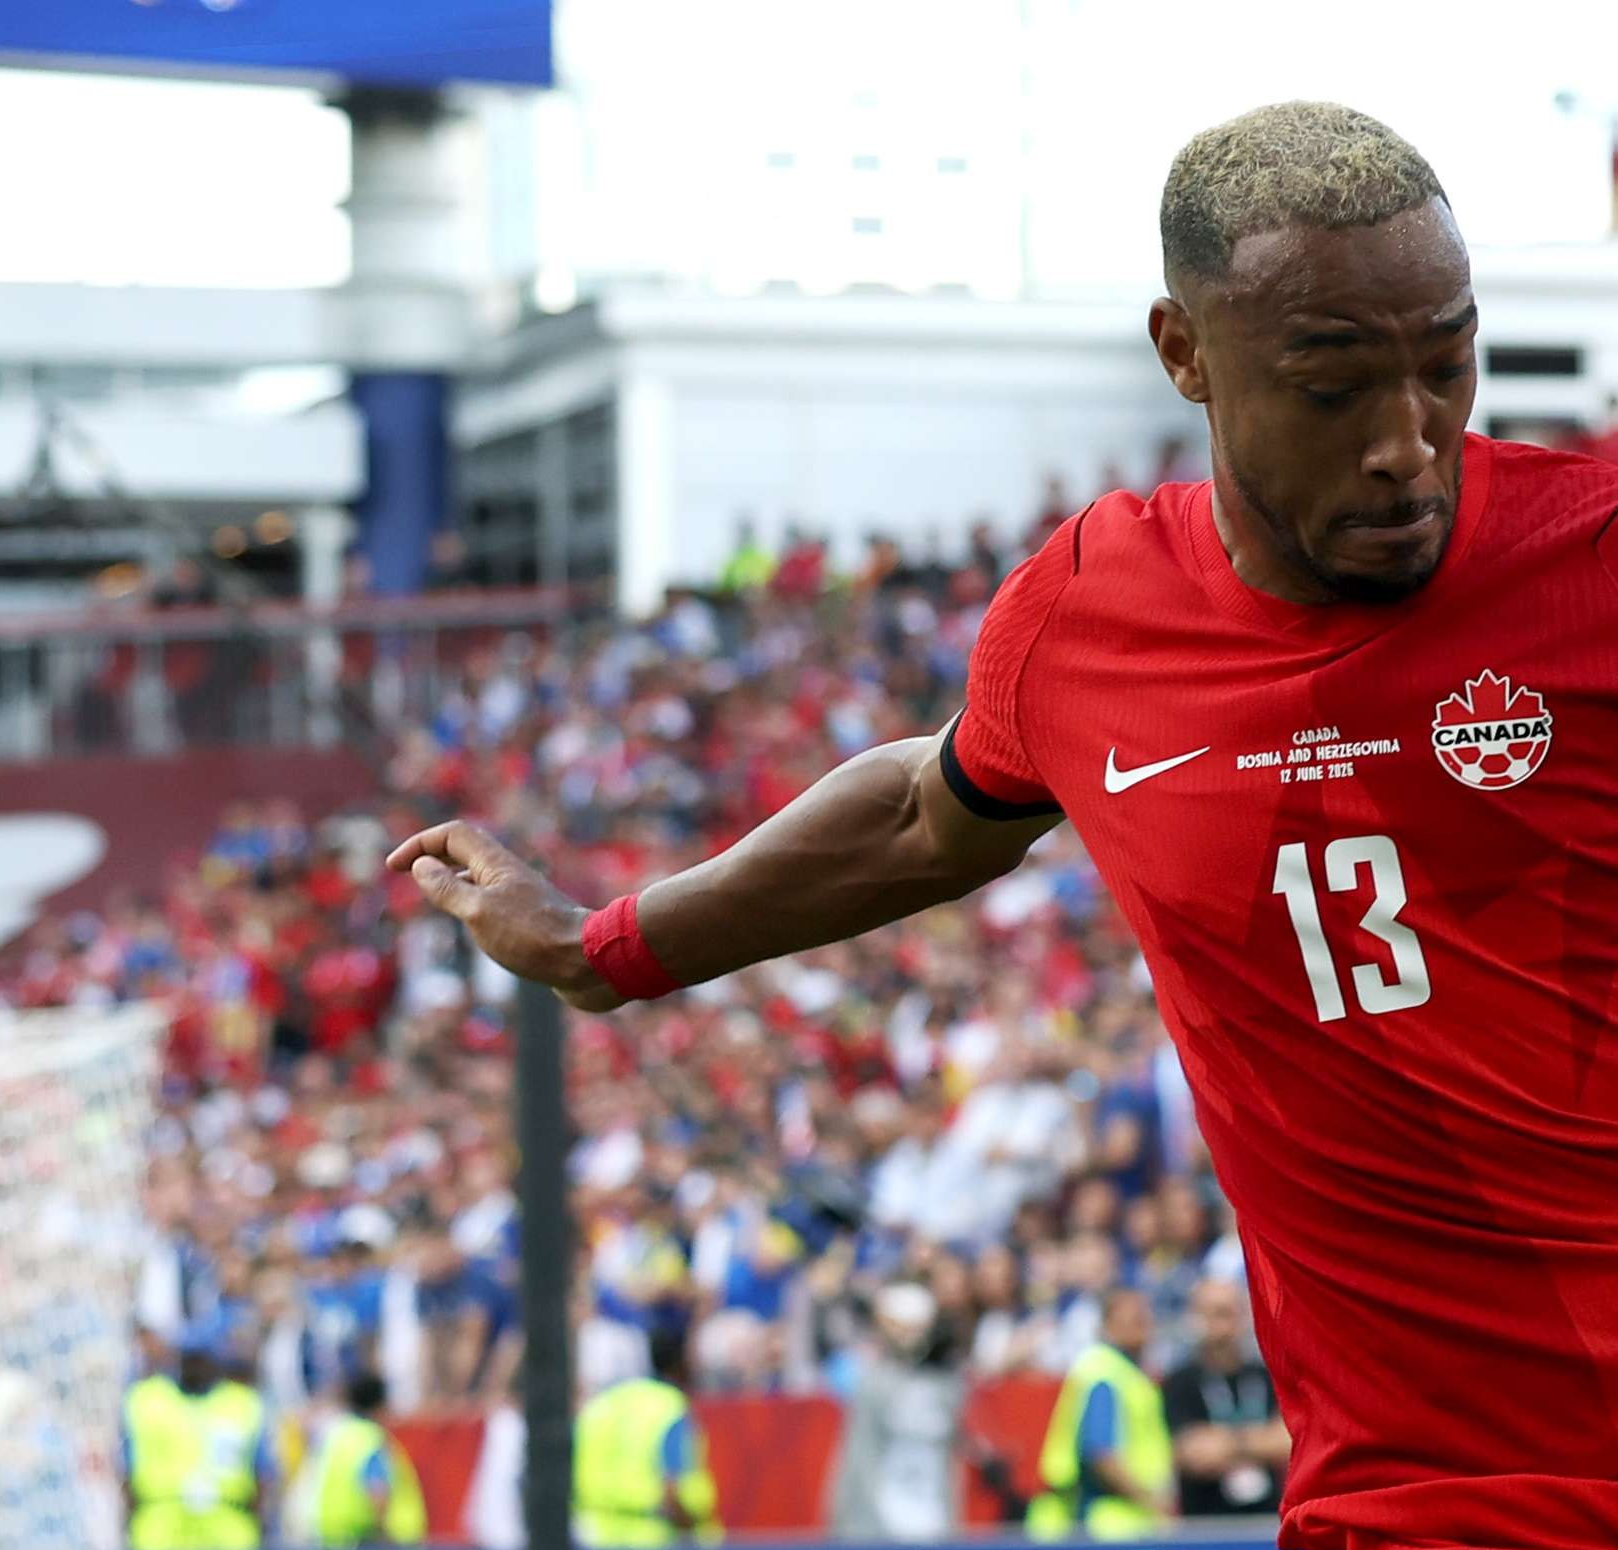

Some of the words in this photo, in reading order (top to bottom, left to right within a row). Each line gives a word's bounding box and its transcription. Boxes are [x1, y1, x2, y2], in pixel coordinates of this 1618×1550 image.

[1292, 726, 1341, 745] CANADA
[1434, 719, 1549, 747] CANADA
[1236, 751, 1282, 770] BOSNIA
[1287, 747, 1312, 765] AND
[1315, 738, 1400, 760] HERZEGOVINA
[1279, 767, 1292, 783] 12
[1295, 765, 1324, 782] JUNE
[1327, 761, 1355, 779] 2026
[1272, 833, 1431, 1023] 13
